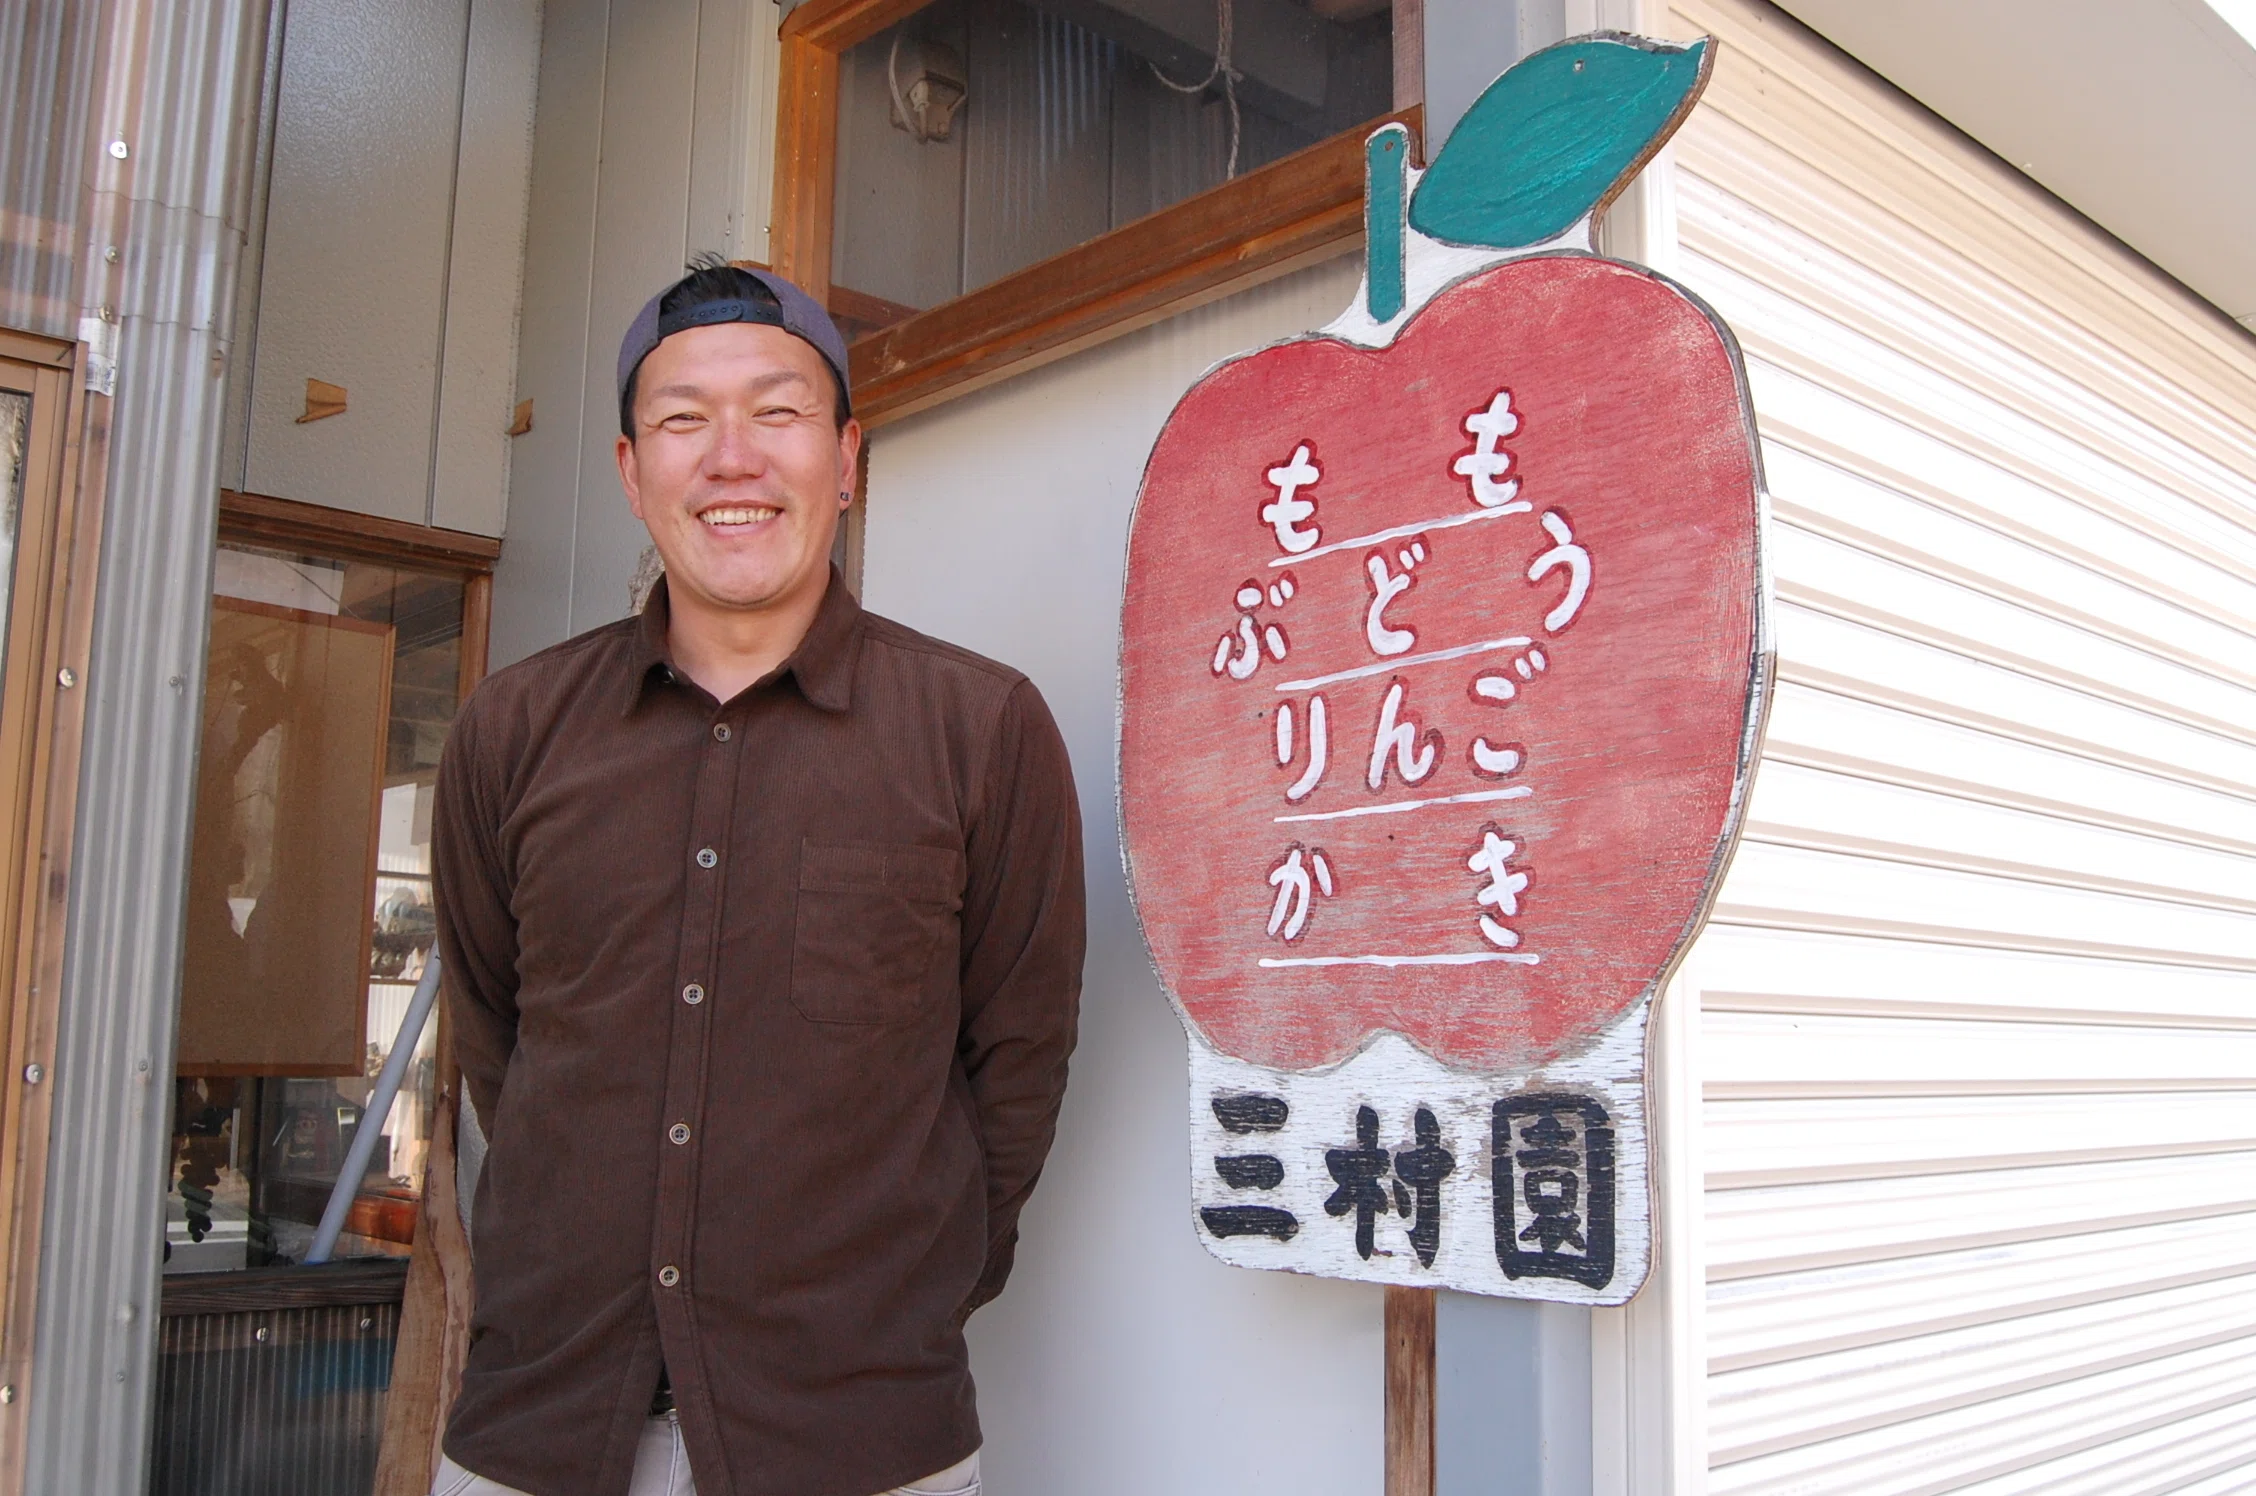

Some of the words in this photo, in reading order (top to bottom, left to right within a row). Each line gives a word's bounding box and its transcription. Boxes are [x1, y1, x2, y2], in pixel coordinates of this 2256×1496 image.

[1260, 390, 1523, 553] もも
[1212, 508, 1594, 679] ぶどう
[1277, 648, 1546, 800] りんご
[1266, 825, 1532, 946] かき
[1201, 1093, 1615, 1290] 三村園
